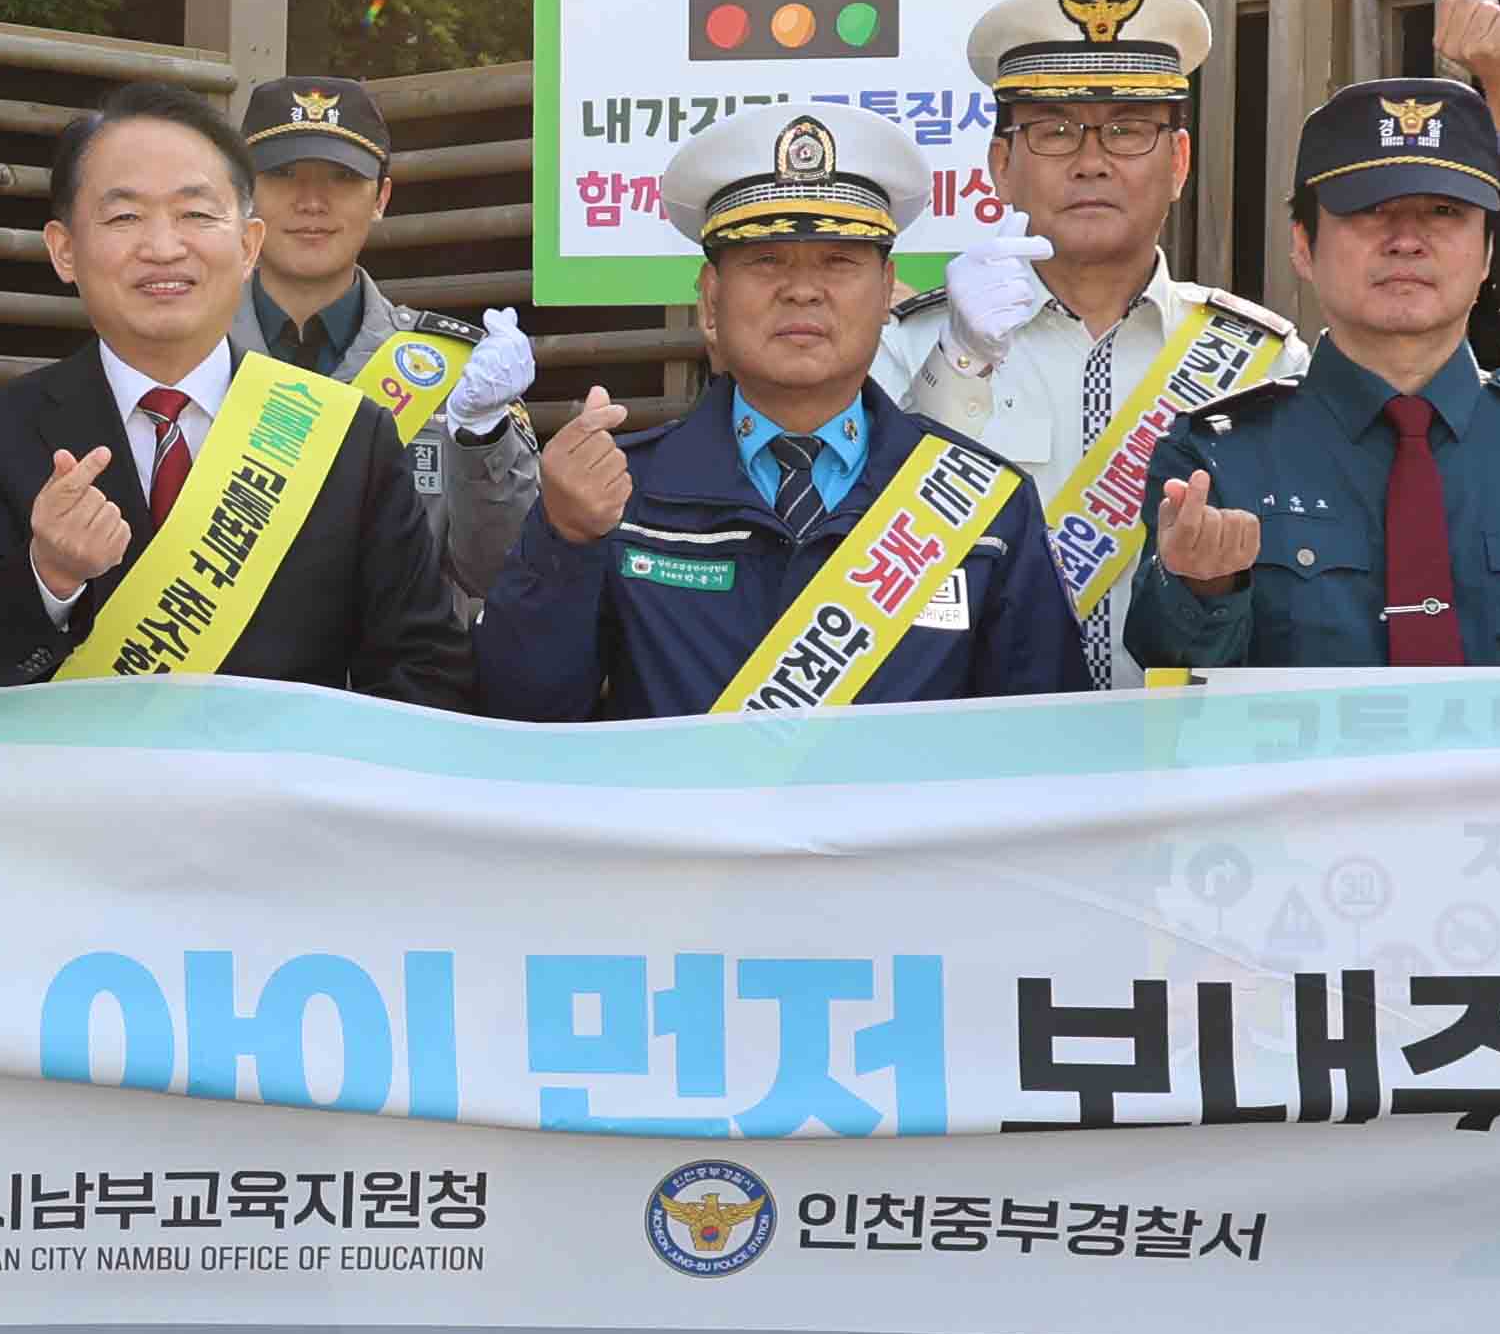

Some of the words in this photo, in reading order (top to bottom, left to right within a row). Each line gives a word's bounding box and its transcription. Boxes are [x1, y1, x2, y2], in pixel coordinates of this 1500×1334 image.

[248, 380, 324, 468] 스쿨존
[189, 453, 288, 590] 교통법규
[848, 512, 947, 614] 낮게
[39, 947, 460, 1123] 아이
[525, 952, 950, 1140] 먼저
[32, 1246, 89, 1272] CITY
[97, 1246, 191, 1272] NAMBU
[201, 1245, 289, 1271] OFFICE
[297, 1245, 332, 1271] OF
[340, 1244, 485, 1271] EDUCATION
[797, 1191, 1268, 1262] 인천중부경찰서
